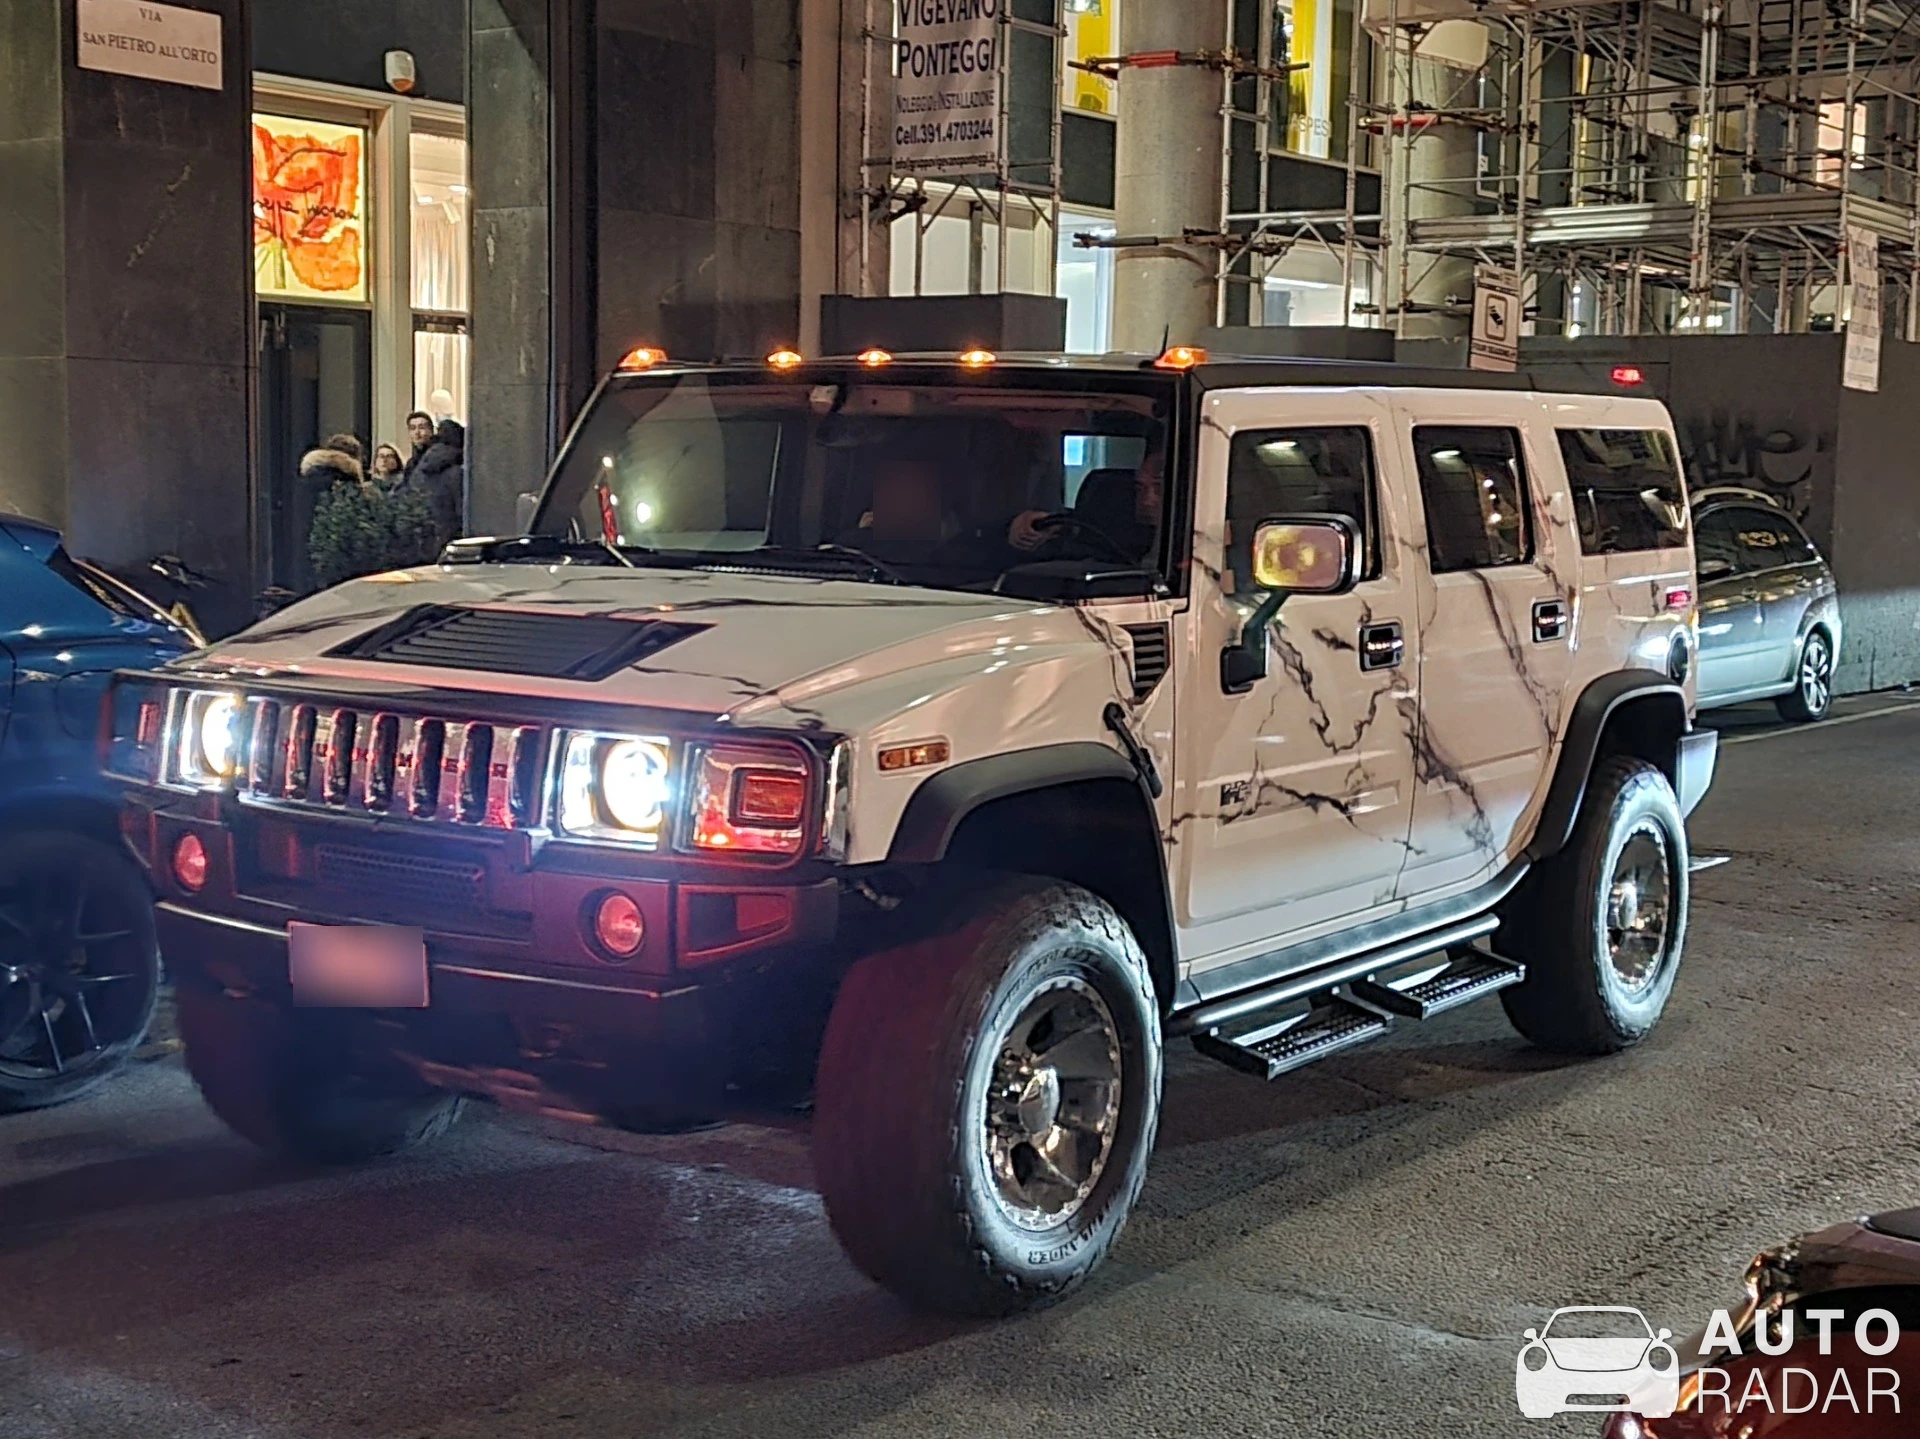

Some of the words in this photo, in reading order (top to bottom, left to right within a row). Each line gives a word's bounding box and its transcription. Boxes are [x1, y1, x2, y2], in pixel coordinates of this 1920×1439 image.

[139, 7, 163, 23] VIA
[901, 0, 997, 27] VIGEVANO
[82, 31, 107, 46] SAN
[108, 34, 156, 55] PIETRO
[159, 45, 218, 65] ALL'ORTO
[899, 37, 996, 79] PONTEGGI
